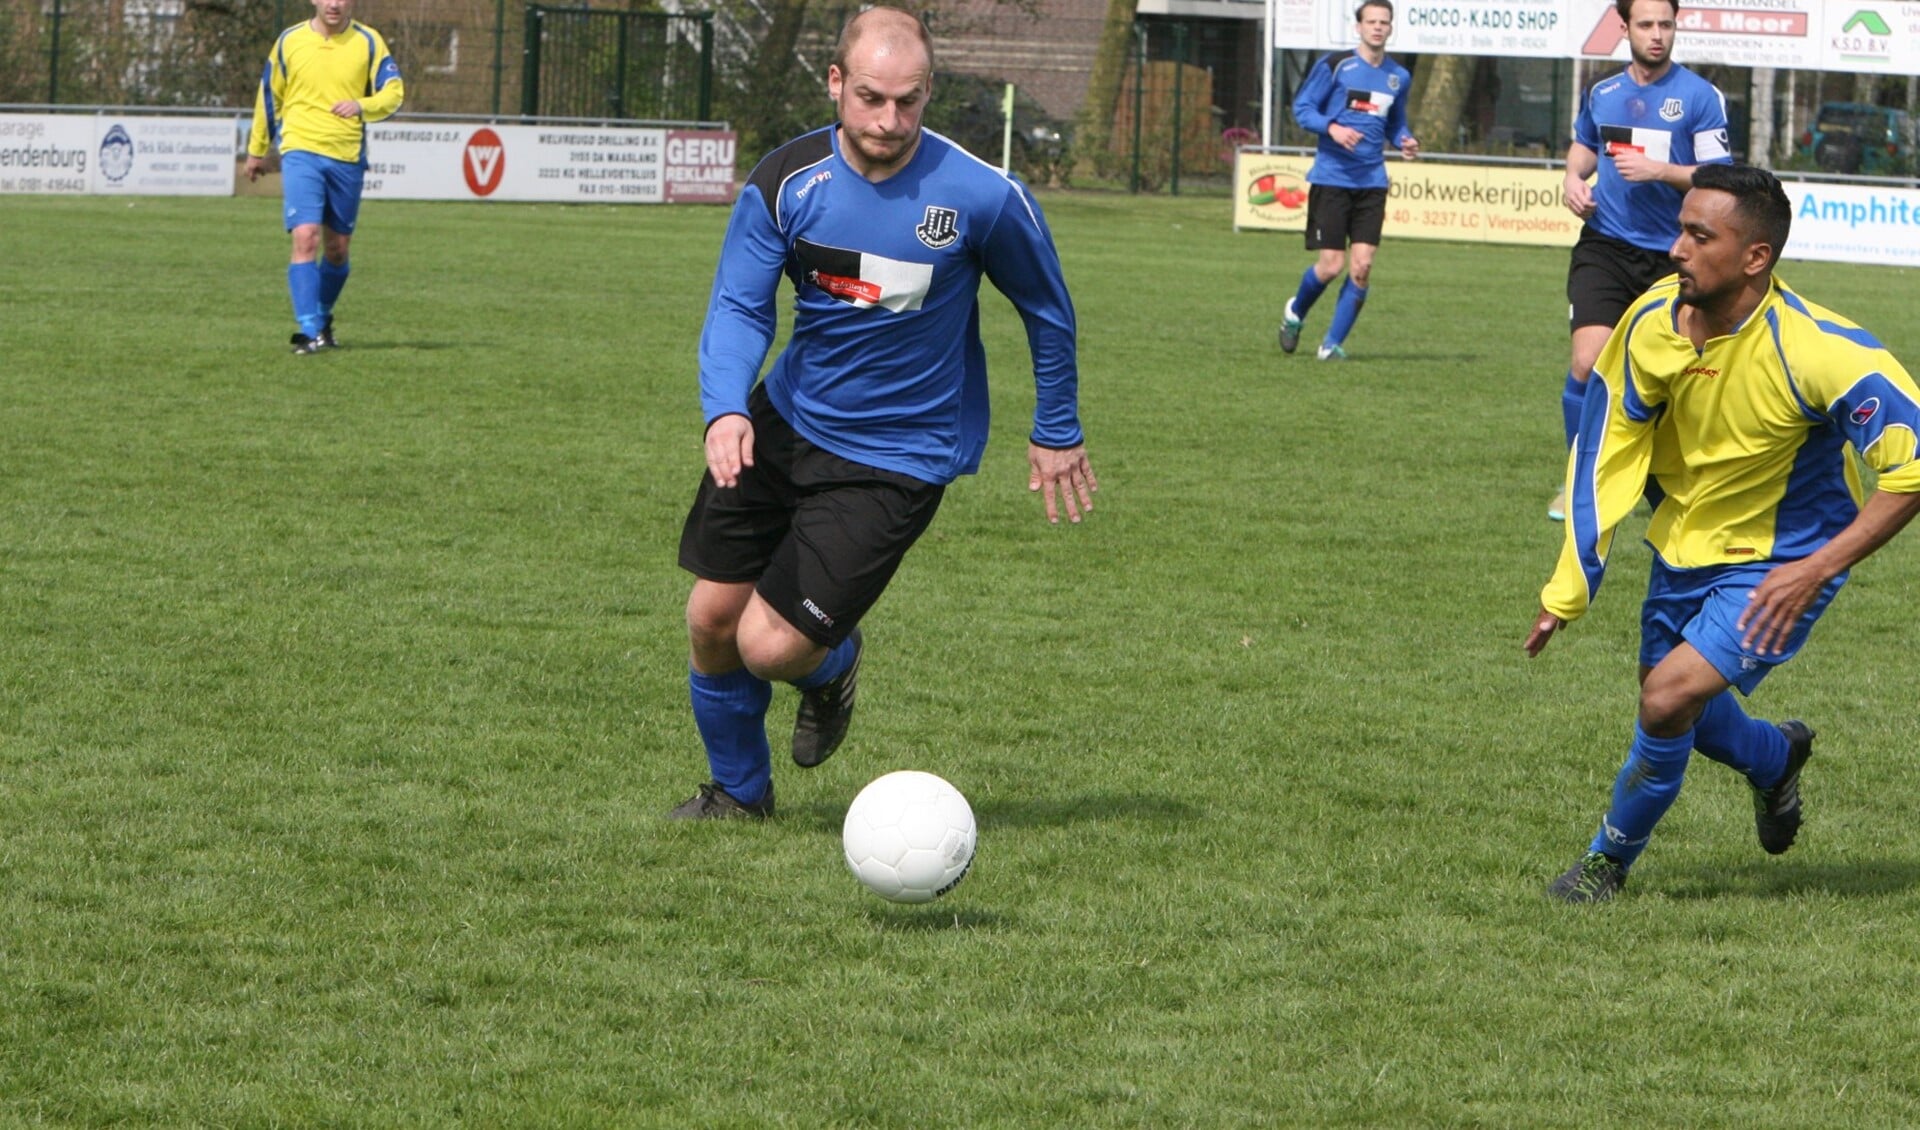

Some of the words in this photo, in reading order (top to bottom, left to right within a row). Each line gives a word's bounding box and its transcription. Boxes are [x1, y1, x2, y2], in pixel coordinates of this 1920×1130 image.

[1517, 11, 1558, 30] SHOP
[1676, 11, 1711, 29] .d.
[0, 122, 44, 140] arage
[0, 144, 86, 173] endenburg
[667, 138, 735, 165] GERU
[666, 165, 734, 183] REKLAME
[796, 170, 832, 199] macron
[1393, 210, 1410, 224] 40
[1421, 212, 1456, 228] 3237
[1461, 213, 1480, 228] LC
[1486, 214, 1571, 233] Vierpolders
